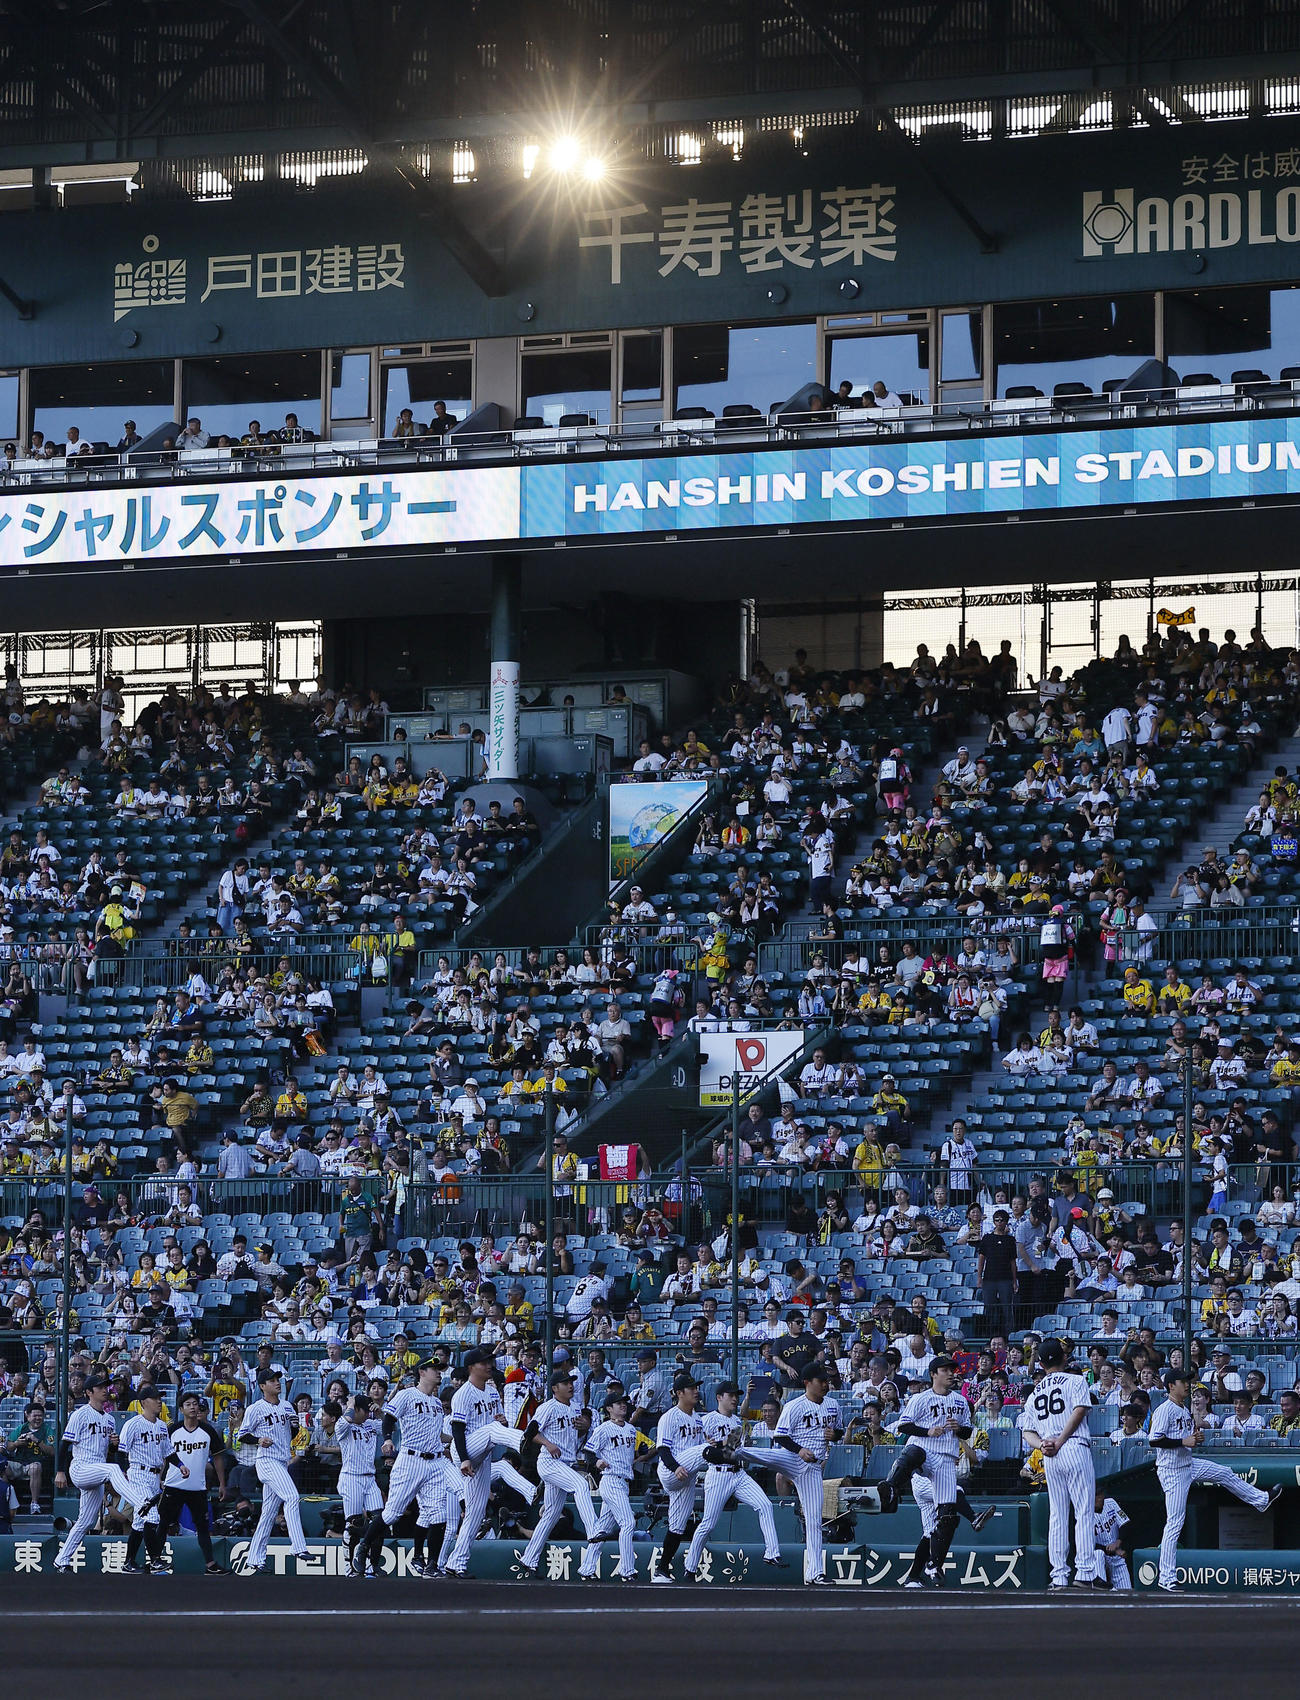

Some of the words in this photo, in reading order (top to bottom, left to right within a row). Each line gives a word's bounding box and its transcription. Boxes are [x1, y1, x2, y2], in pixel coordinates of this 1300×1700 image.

[578, 184, 898, 285] 千寿製薬
[201, 243, 406, 304] 戸田建設
[574, 472, 807, 513] HANSHIN
[821, 457, 1060, 499] KOSHIEN
[0, 481, 457, 558] シャルスポンサー
[494, 691, 505, 771] 三ツ矢サイダー
[874, 965, 893, 974] Tigers
[575, 1283, 587, 1296] 8
[647, 1273, 654, 1286] 1
[783, 1344, 808, 1357] OSAK
[1034, 1388, 1065, 1420] 96
[174, 1440, 208, 1454] Tigers
[1176, 1567, 1230, 1585] OMPO
